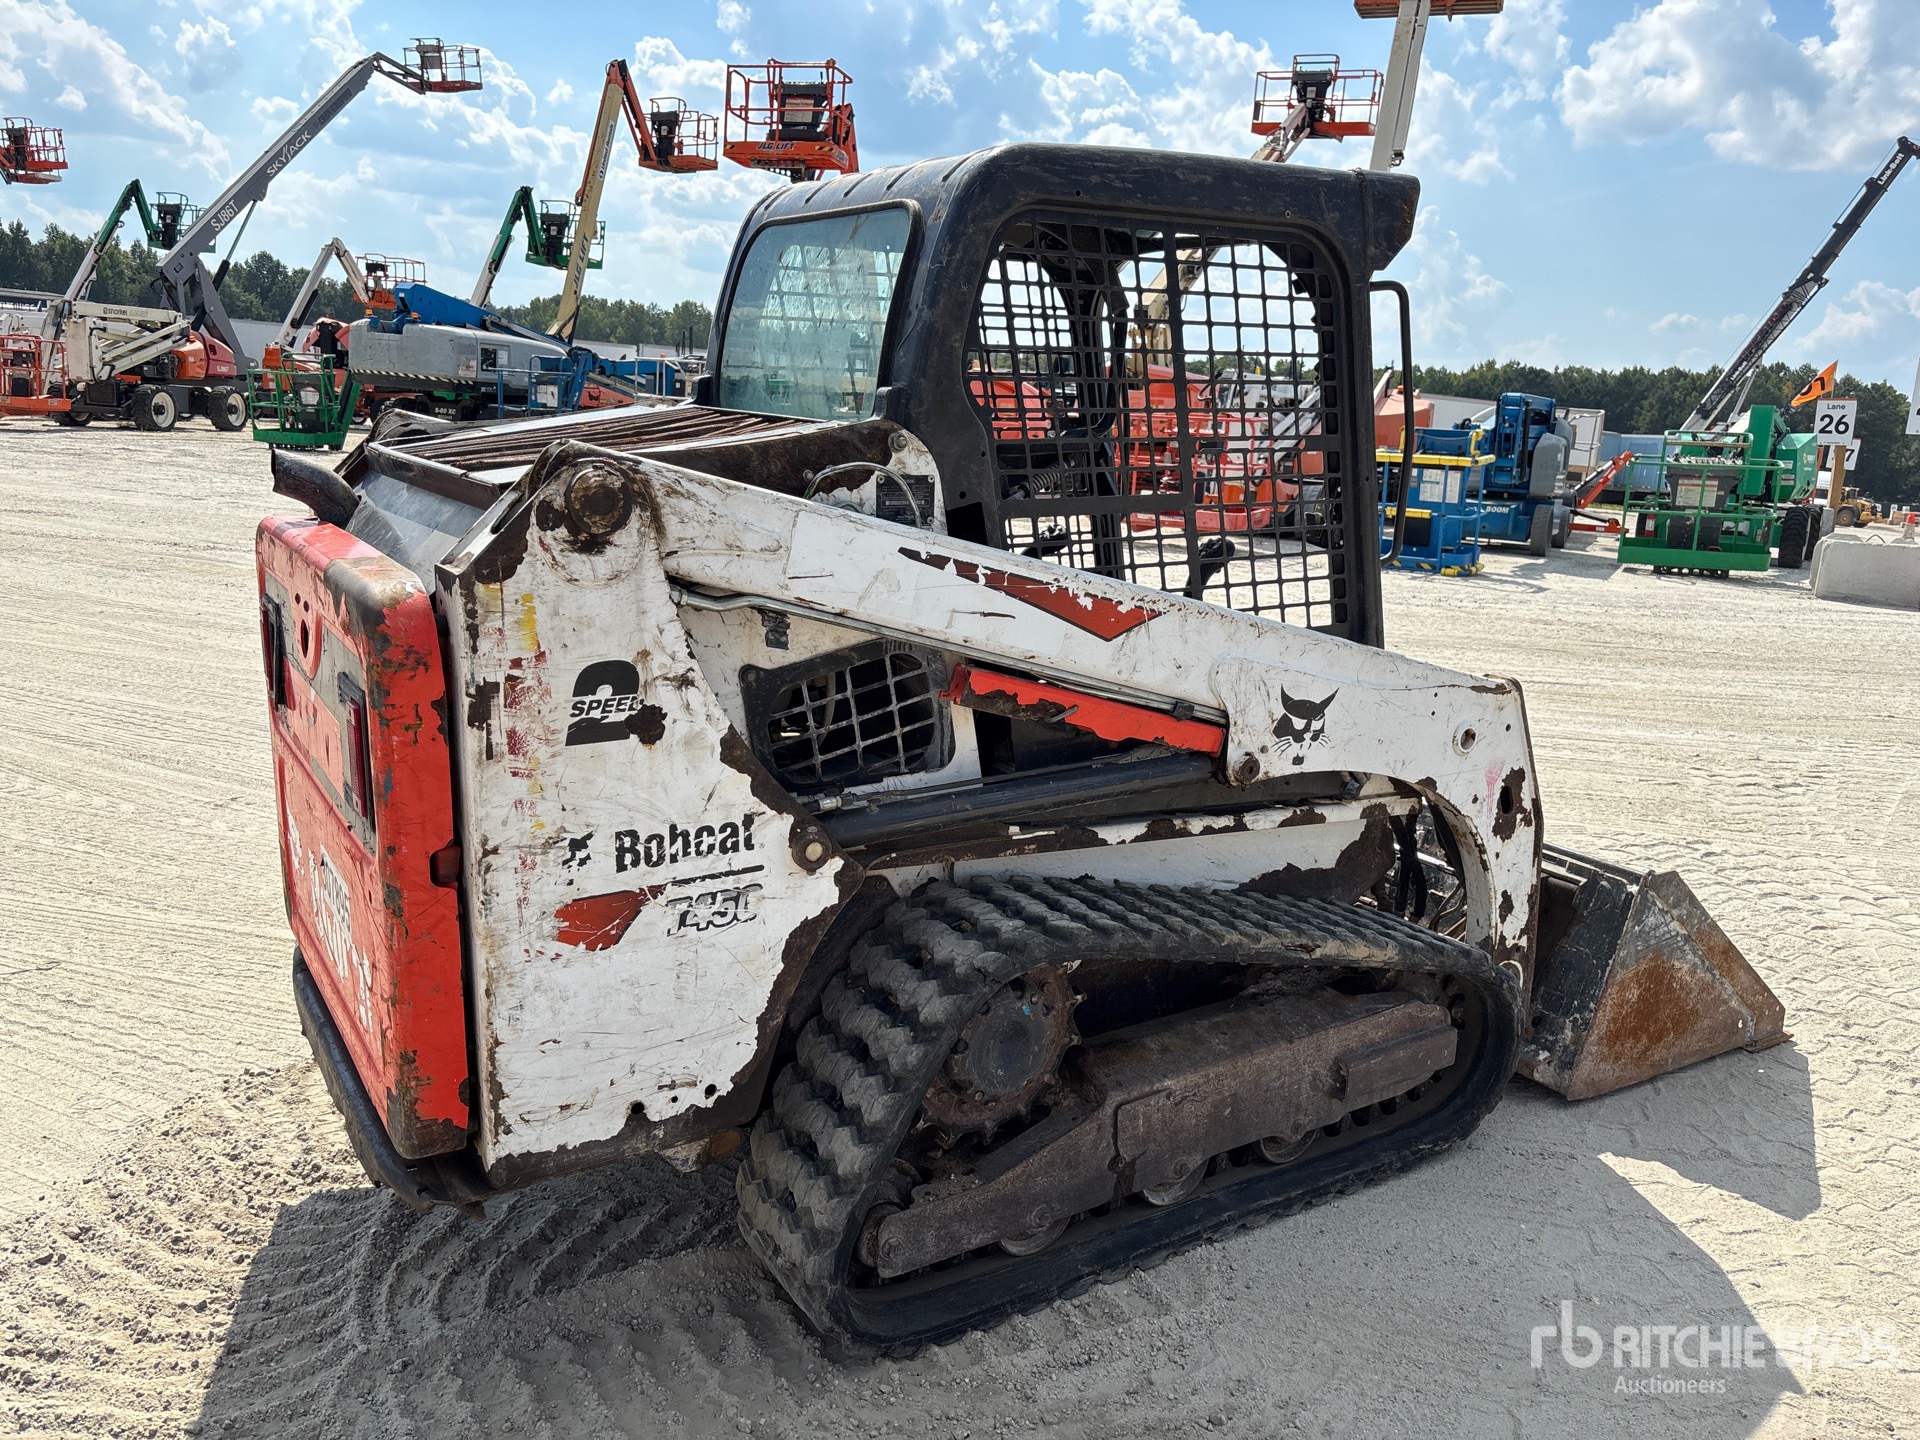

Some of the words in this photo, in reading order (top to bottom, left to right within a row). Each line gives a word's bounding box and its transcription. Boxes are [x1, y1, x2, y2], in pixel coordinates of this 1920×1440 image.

[266, 130, 312, 177] SKYJACK
[758, 142, 773, 150] JLG
[775, 142, 796, 150] LIFT
[1877, 152, 1905, 186] Link-Belt
[210, 199, 239, 232] SJ86T
[573, 263, 583, 289] JLG
[579, 232, 590, 263] LIFT
[1827, 402, 1846, 410] Lane
[1818, 413, 1850, 435] 26
[1485, 505, 1510, 514] BOOM
[565, 659, 640, 746] 2
[614, 812, 756, 873] Bobcat
